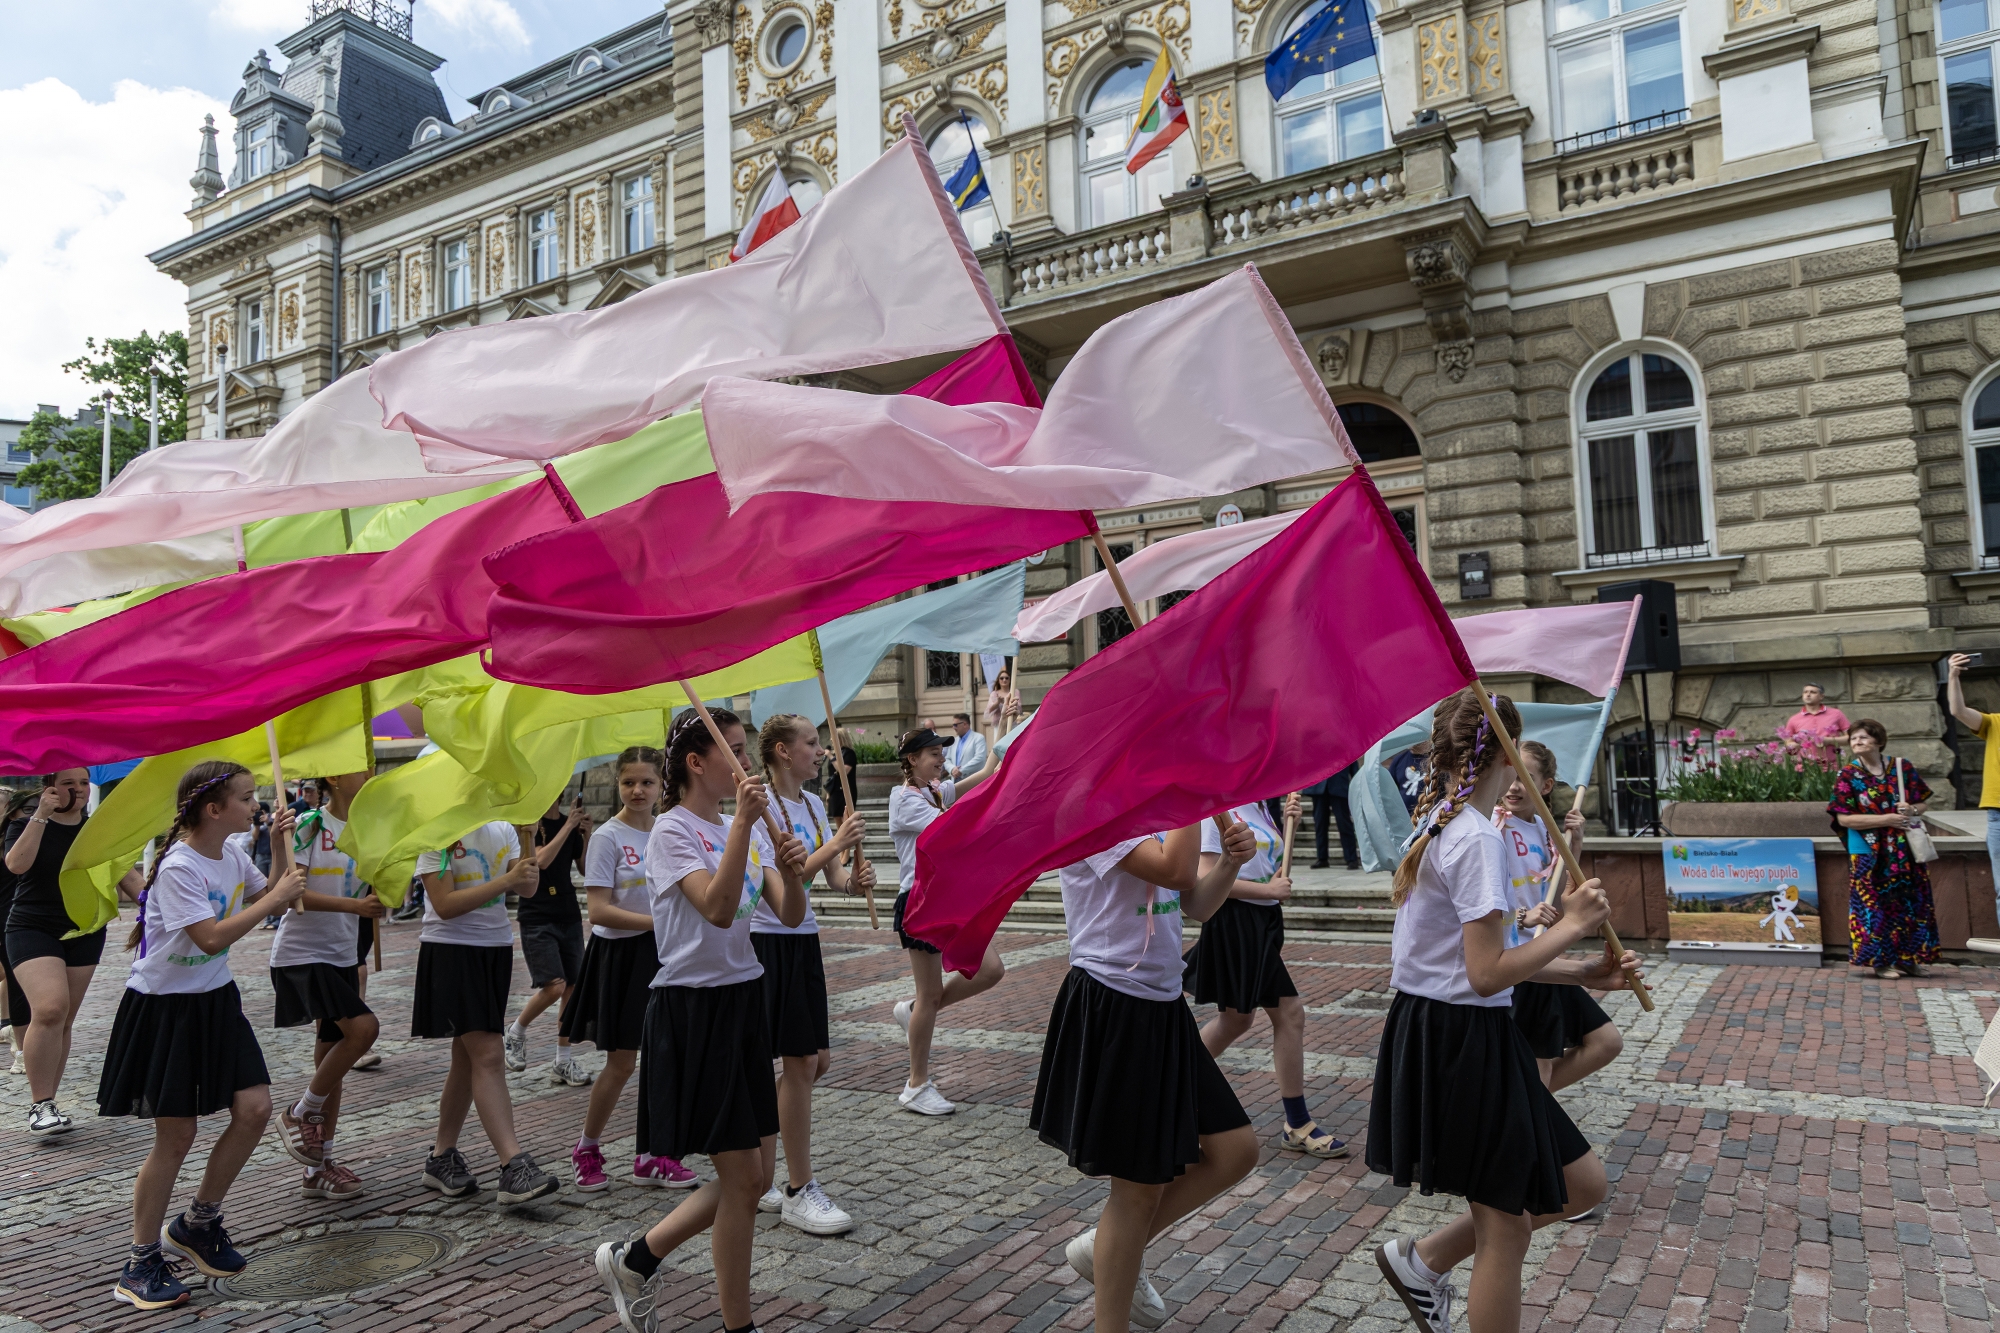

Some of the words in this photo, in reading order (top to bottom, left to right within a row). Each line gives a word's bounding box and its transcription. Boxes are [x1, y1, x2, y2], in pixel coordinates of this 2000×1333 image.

[322, 829, 335, 852] B
[1511, 831, 1528, 857] B
[622, 846, 641, 865] B
[1680, 865, 1707, 878] Woda
[1710, 865, 1725, 878] dla
[1727, 864, 1765, 882] Twojego
[1768, 865, 1798, 882] pupila
